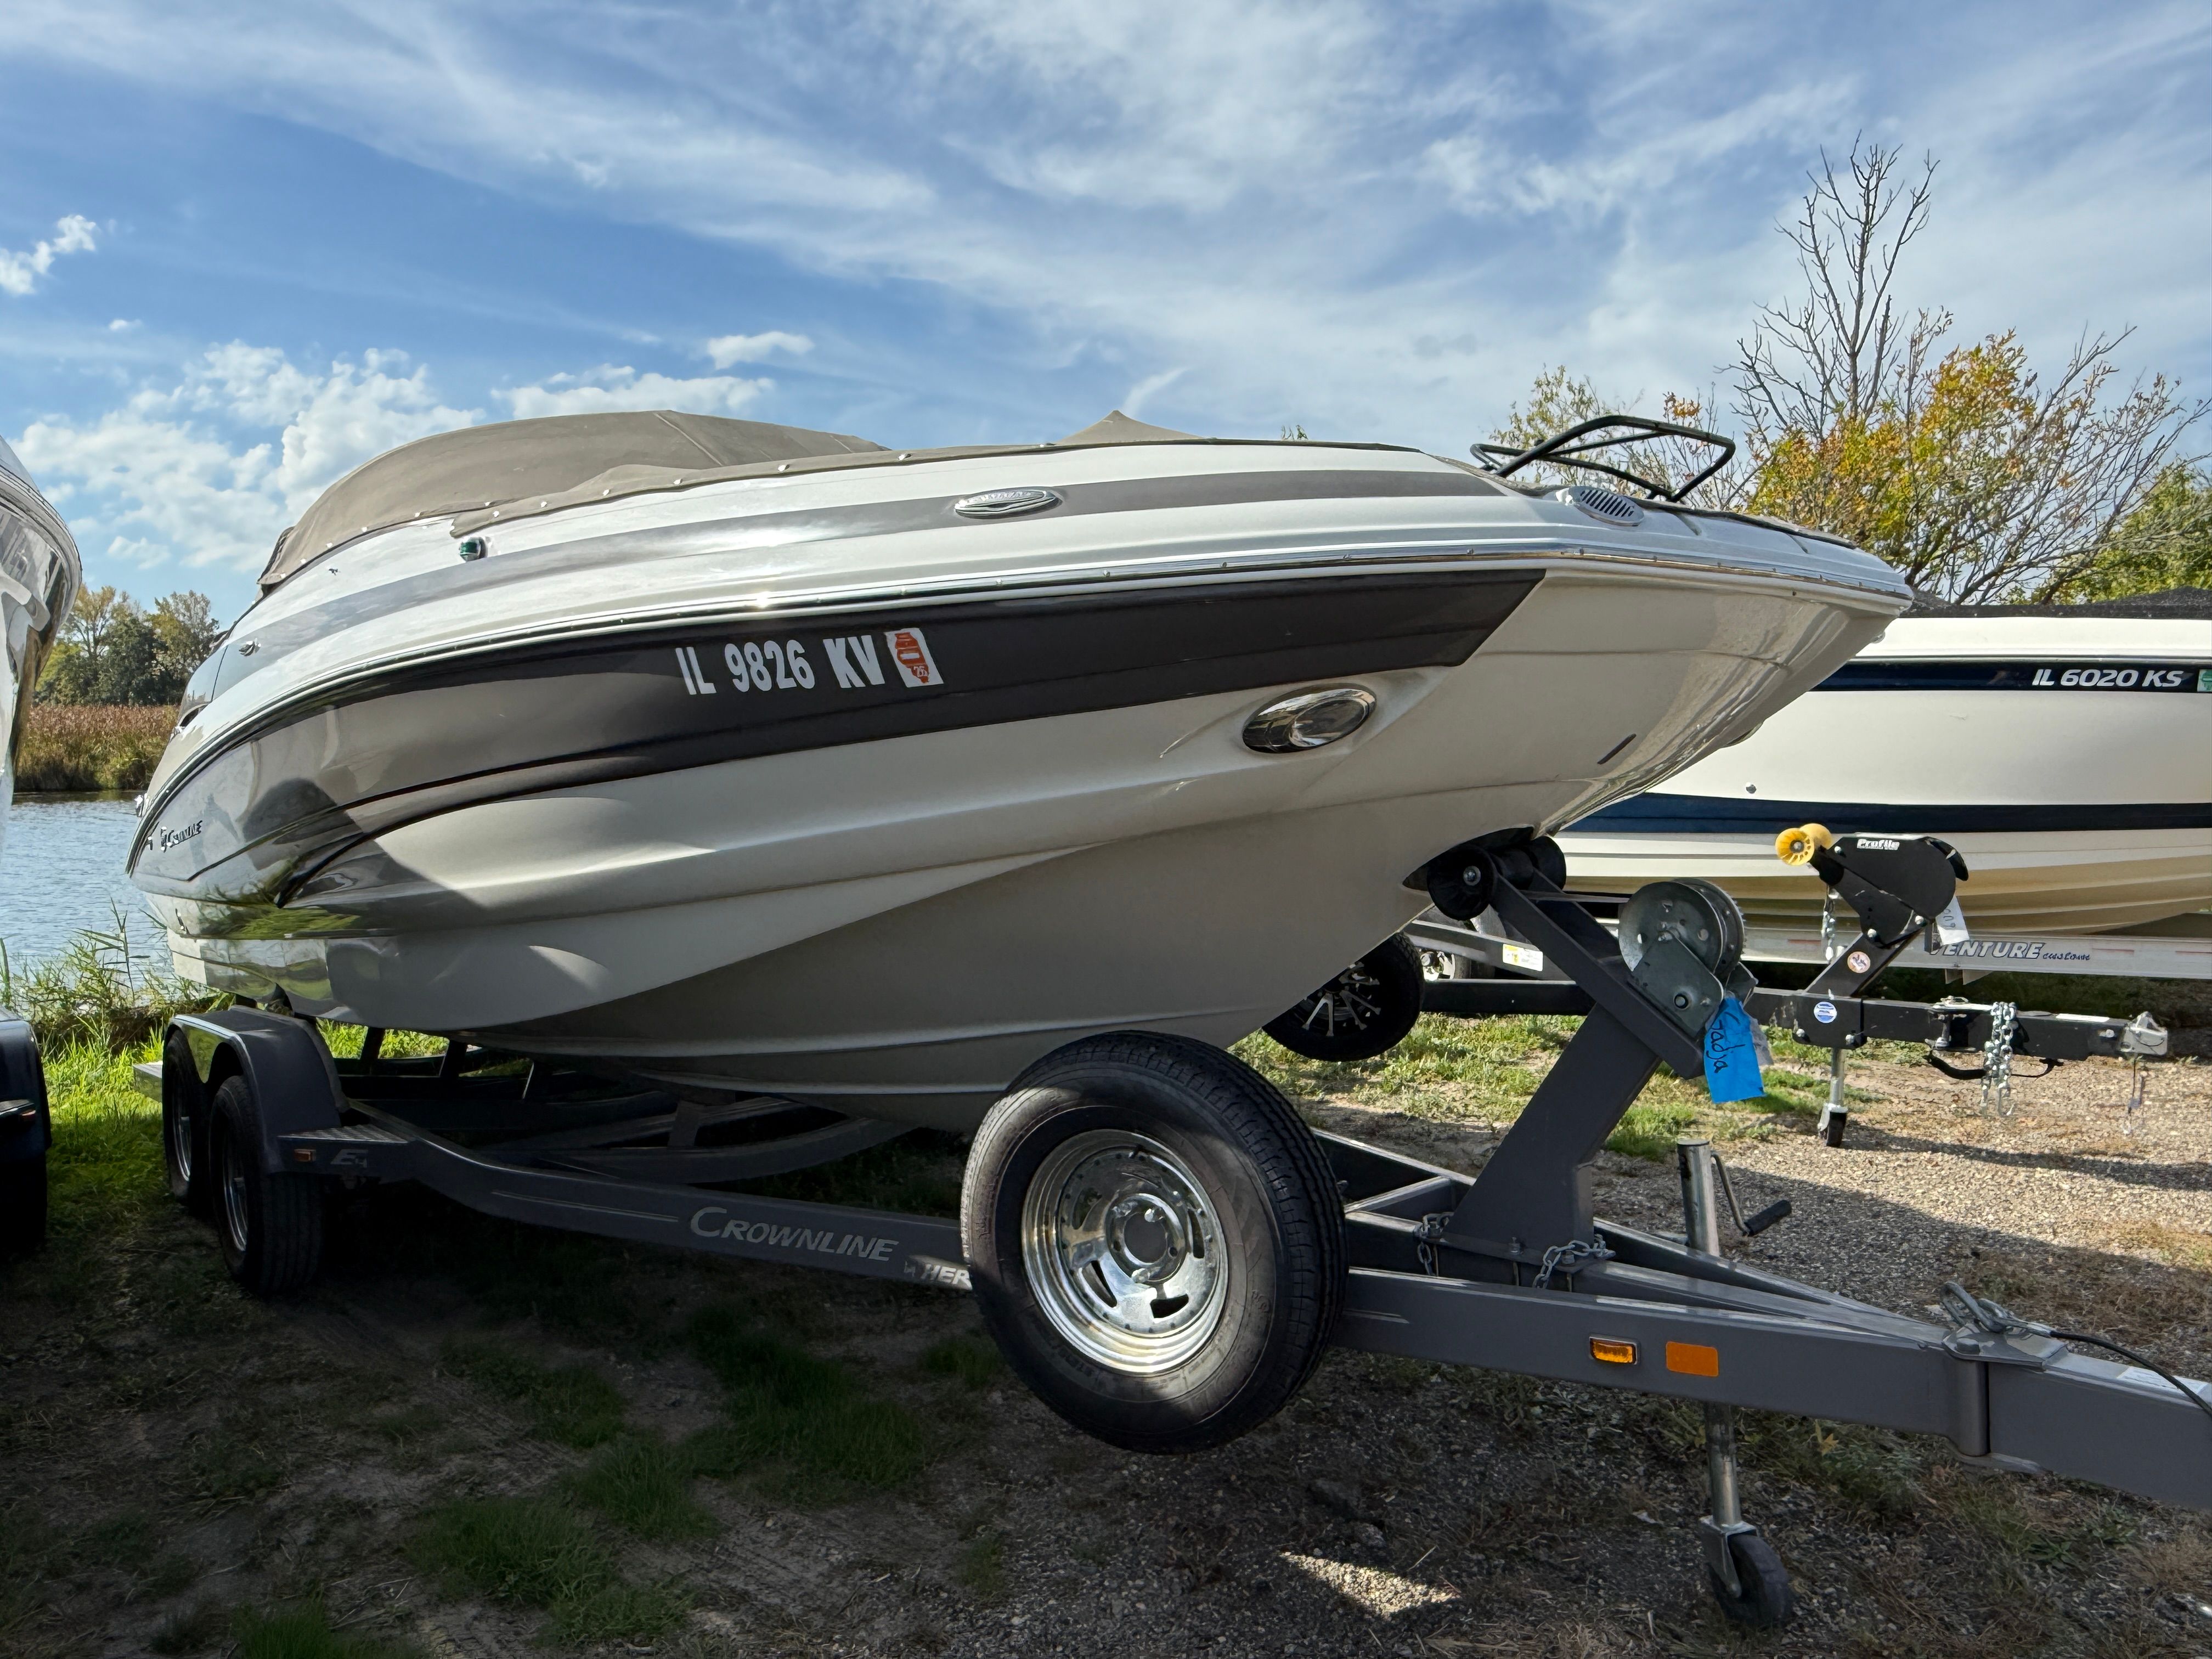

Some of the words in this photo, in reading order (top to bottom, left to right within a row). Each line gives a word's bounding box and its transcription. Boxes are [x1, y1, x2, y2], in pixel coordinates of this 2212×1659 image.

[675, 646, 716, 695] IL
[724, 639, 815, 692] 9826
[823, 635, 885, 689] KV
[2032, 668, 2055, 686] IL
[2061, 669, 2138, 687] 6020
[2142, 670, 2185, 687] KS
